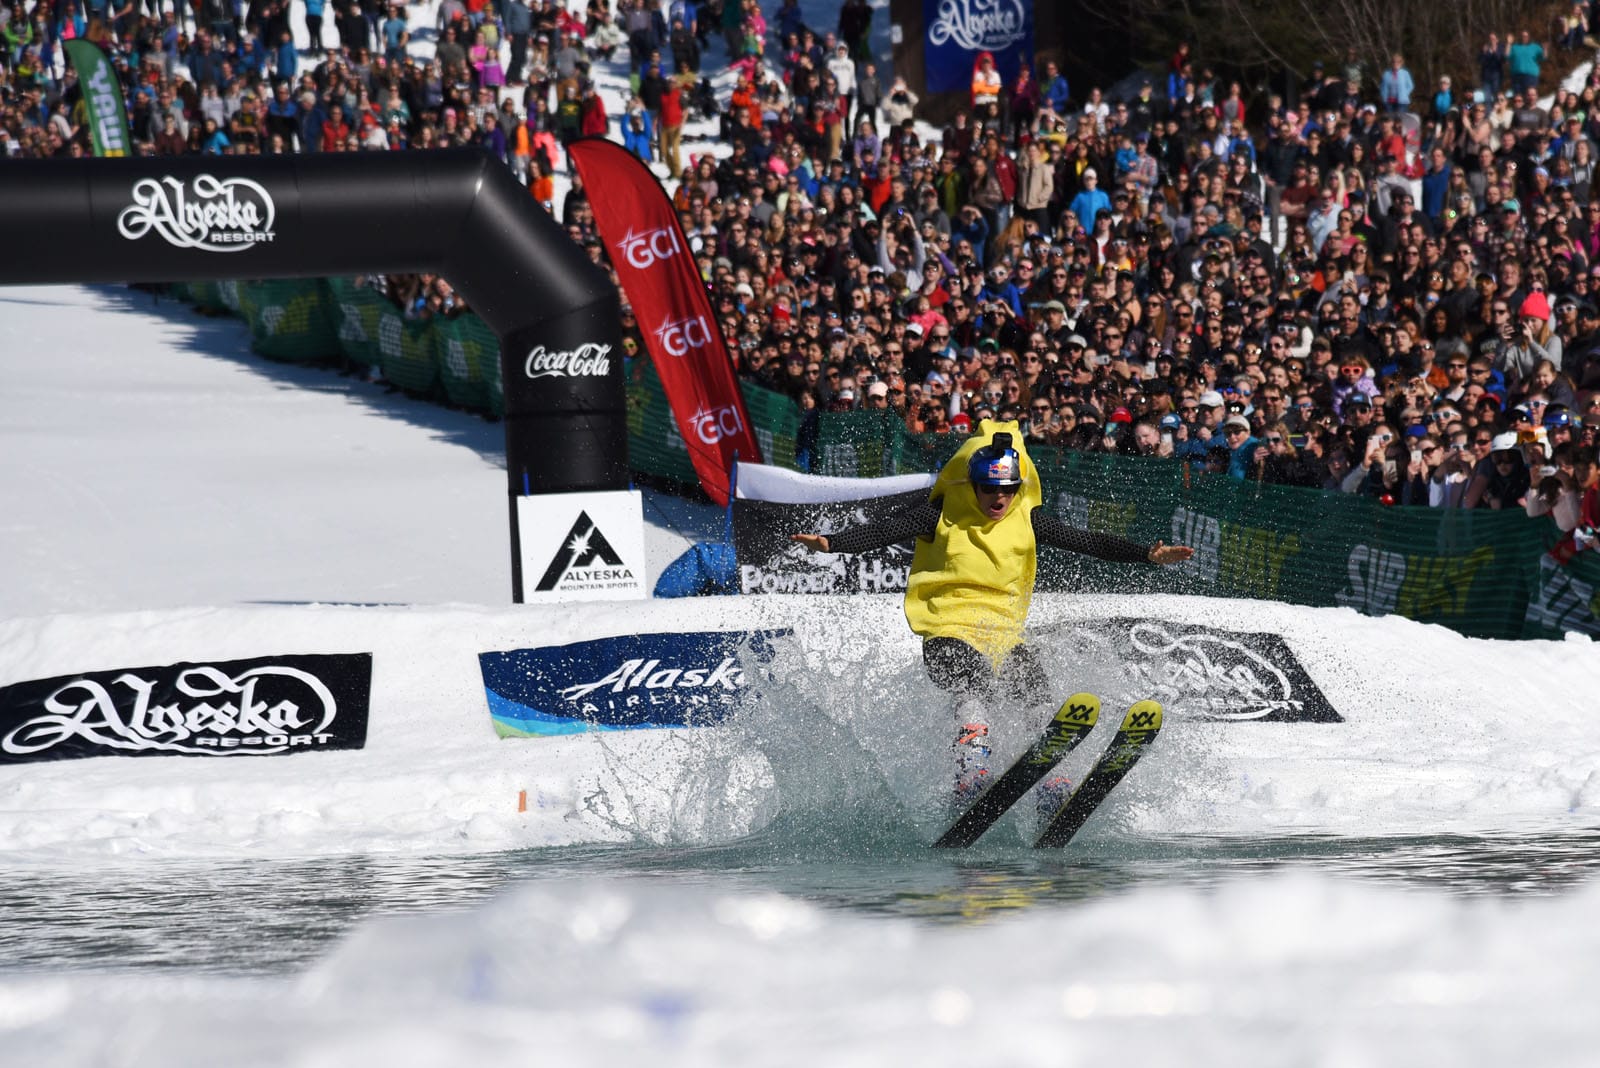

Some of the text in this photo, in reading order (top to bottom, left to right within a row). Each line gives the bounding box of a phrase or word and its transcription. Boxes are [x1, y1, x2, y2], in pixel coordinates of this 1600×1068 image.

[117, 173, 276, 252] Alyeska
[210, 232, 276, 243] RESORT
[626, 225, 681, 269] GCI
[662, 315, 713, 357] GCI
[525, 343, 613, 379] Coca-Cola
[696, 404, 744, 445] GCI
[560, 581, 639, 591] MOUNTAIN SPORTS
[563, 569, 635, 582] ALYESKA
[556, 657, 745, 701] Alask
[1, 665, 338, 755] Alyeska
[582, 693, 757, 716] AIRLINE
[195, 733, 334, 748] RESORT
